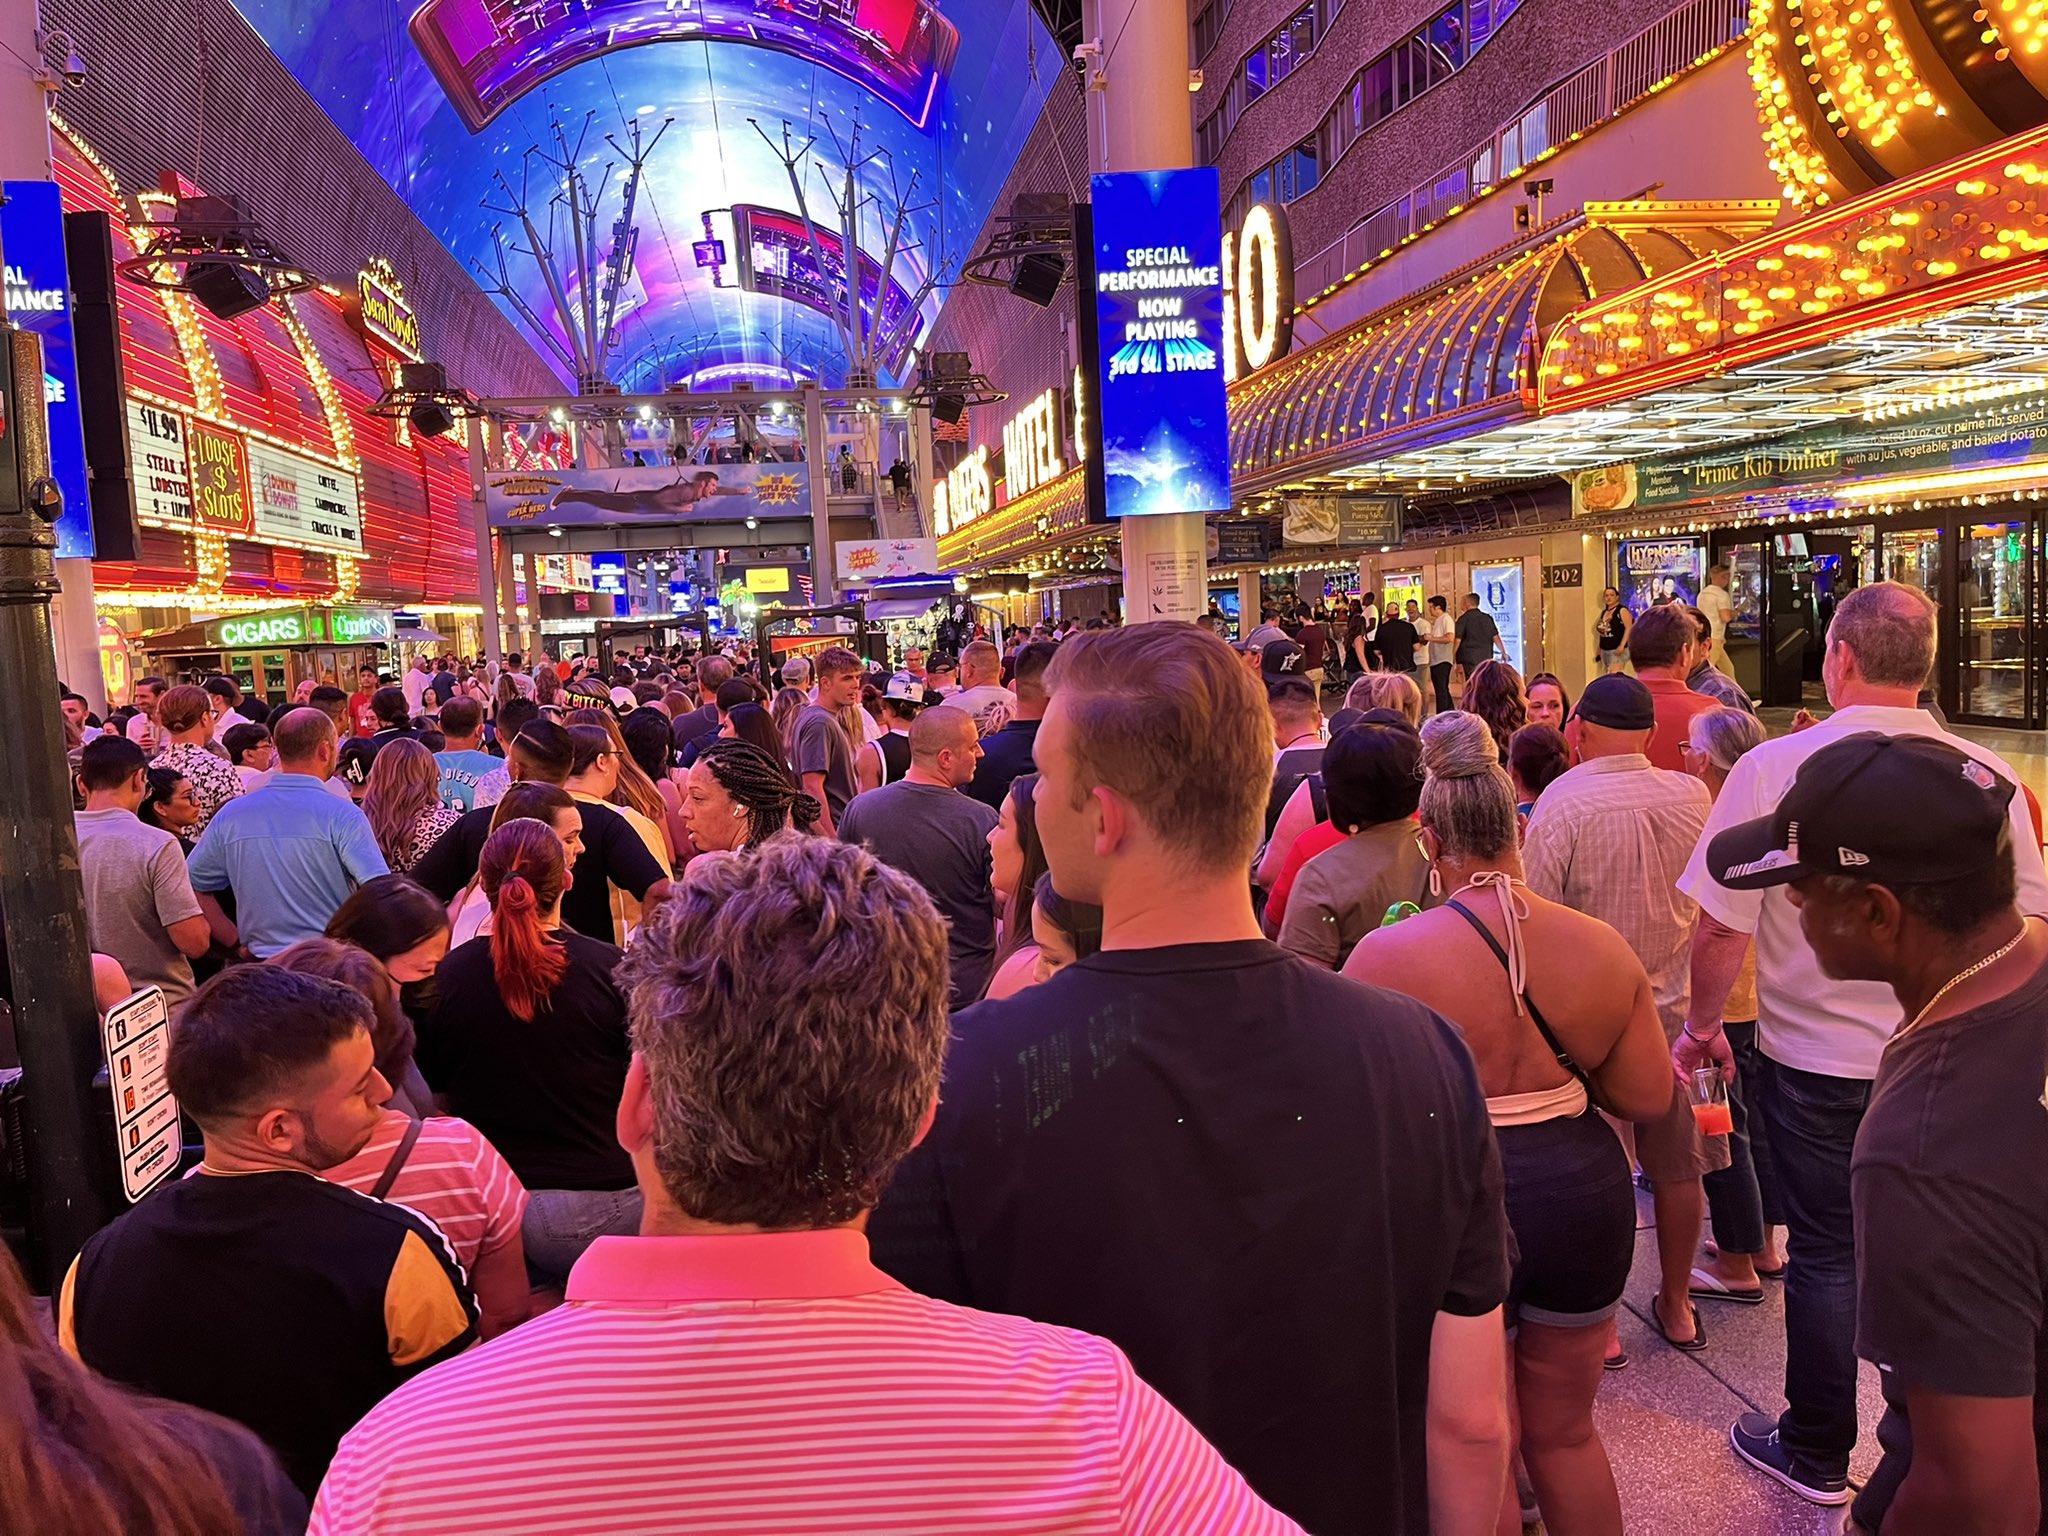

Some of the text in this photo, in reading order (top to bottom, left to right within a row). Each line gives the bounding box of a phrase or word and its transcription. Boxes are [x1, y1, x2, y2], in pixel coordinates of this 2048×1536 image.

[1126, 246, 1190, 267] SPECIAL
[1099, 266, 1219, 292] PERFORMANCE
[1138, 297, 1182, 318] NOW
[1125, 319, 1197, 342] PLAYING
[1109, 356, 1139, 375] 3rd
[1165, 351, 1217, 373] STAGE
[1935, 423, 1952, 435] cut
[1954, 418, 1985, 434] prime
[2007, 408, 2044, 425] served
[198, 432, 238, 475] LOOSE
[1003, 388, 1061, 501] HOTEL
[1846, 426, 2048, 465] with au jus, vegetable, and baked potato
[147, 453, 177, 475] STEAK
[1695, 447, 1839, 486] Prime Rib Dinner
[214, 465, 227, 491] $
[1645, 484, 1680, 498] Food Specials
[204, 486, 242, 521] SLOTS
[508, 504, 546, 518] SUPER HERO
[1631, 544, 1688, 562] HYPNOSIS
[1554, 568, 1578, 584] 202
[221, 618, 300, 645] CIGARS
[572, 693, 604, 709] BITCH
[445, 768, 479, 788] DIEGO
